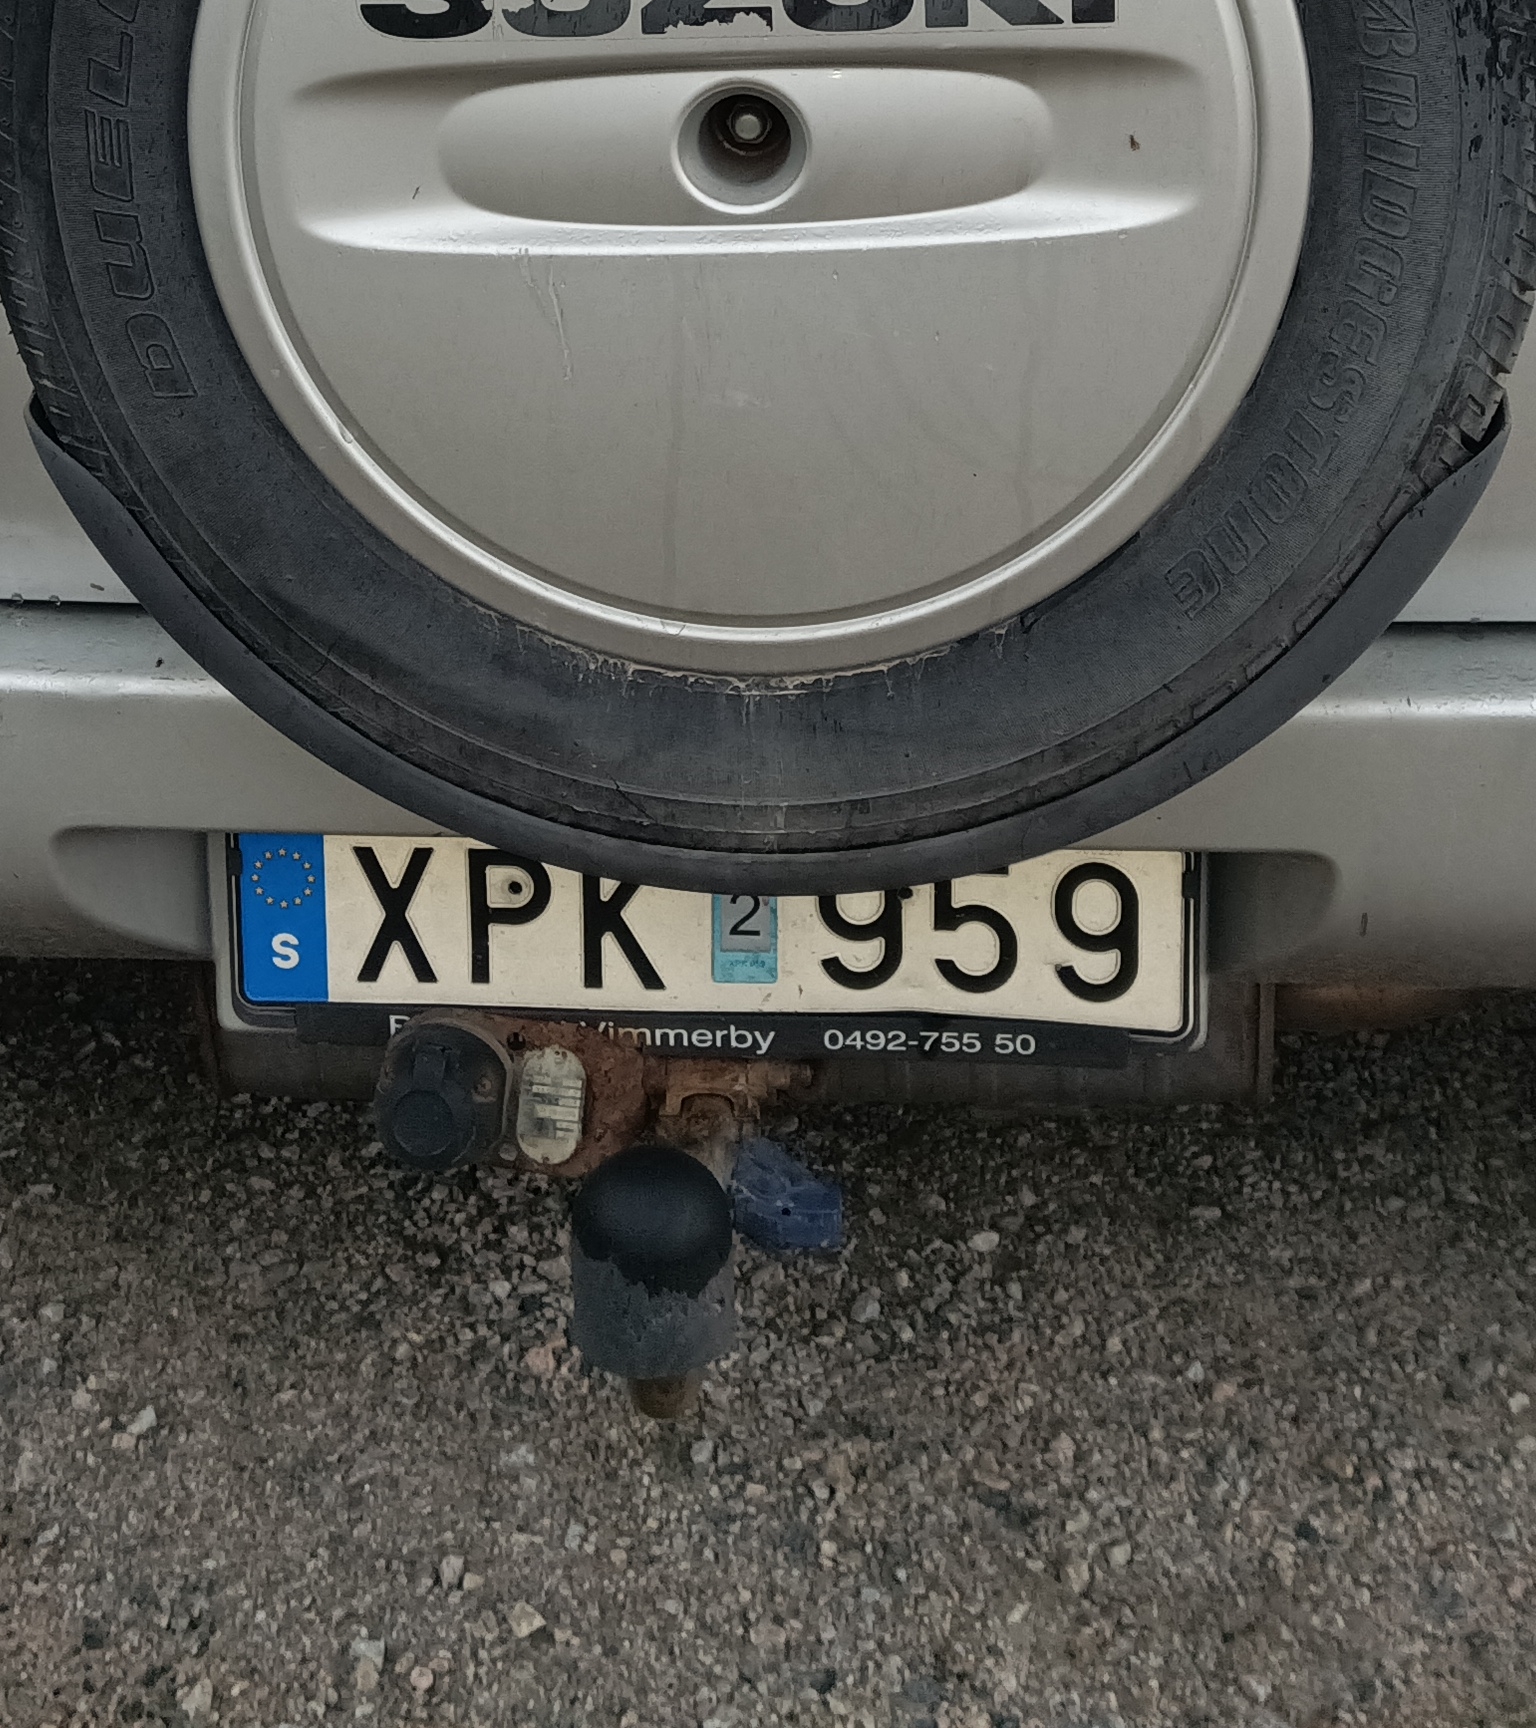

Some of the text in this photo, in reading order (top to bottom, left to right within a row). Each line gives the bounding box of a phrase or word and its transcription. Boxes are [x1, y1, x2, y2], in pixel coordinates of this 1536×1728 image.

[353, 846, 1139, 1003] XPK 959
[271, 932, 300, 970] S
[823, 1029, 982, 1053] 0492-755
[994, 1033, 1036, 1055] 50
